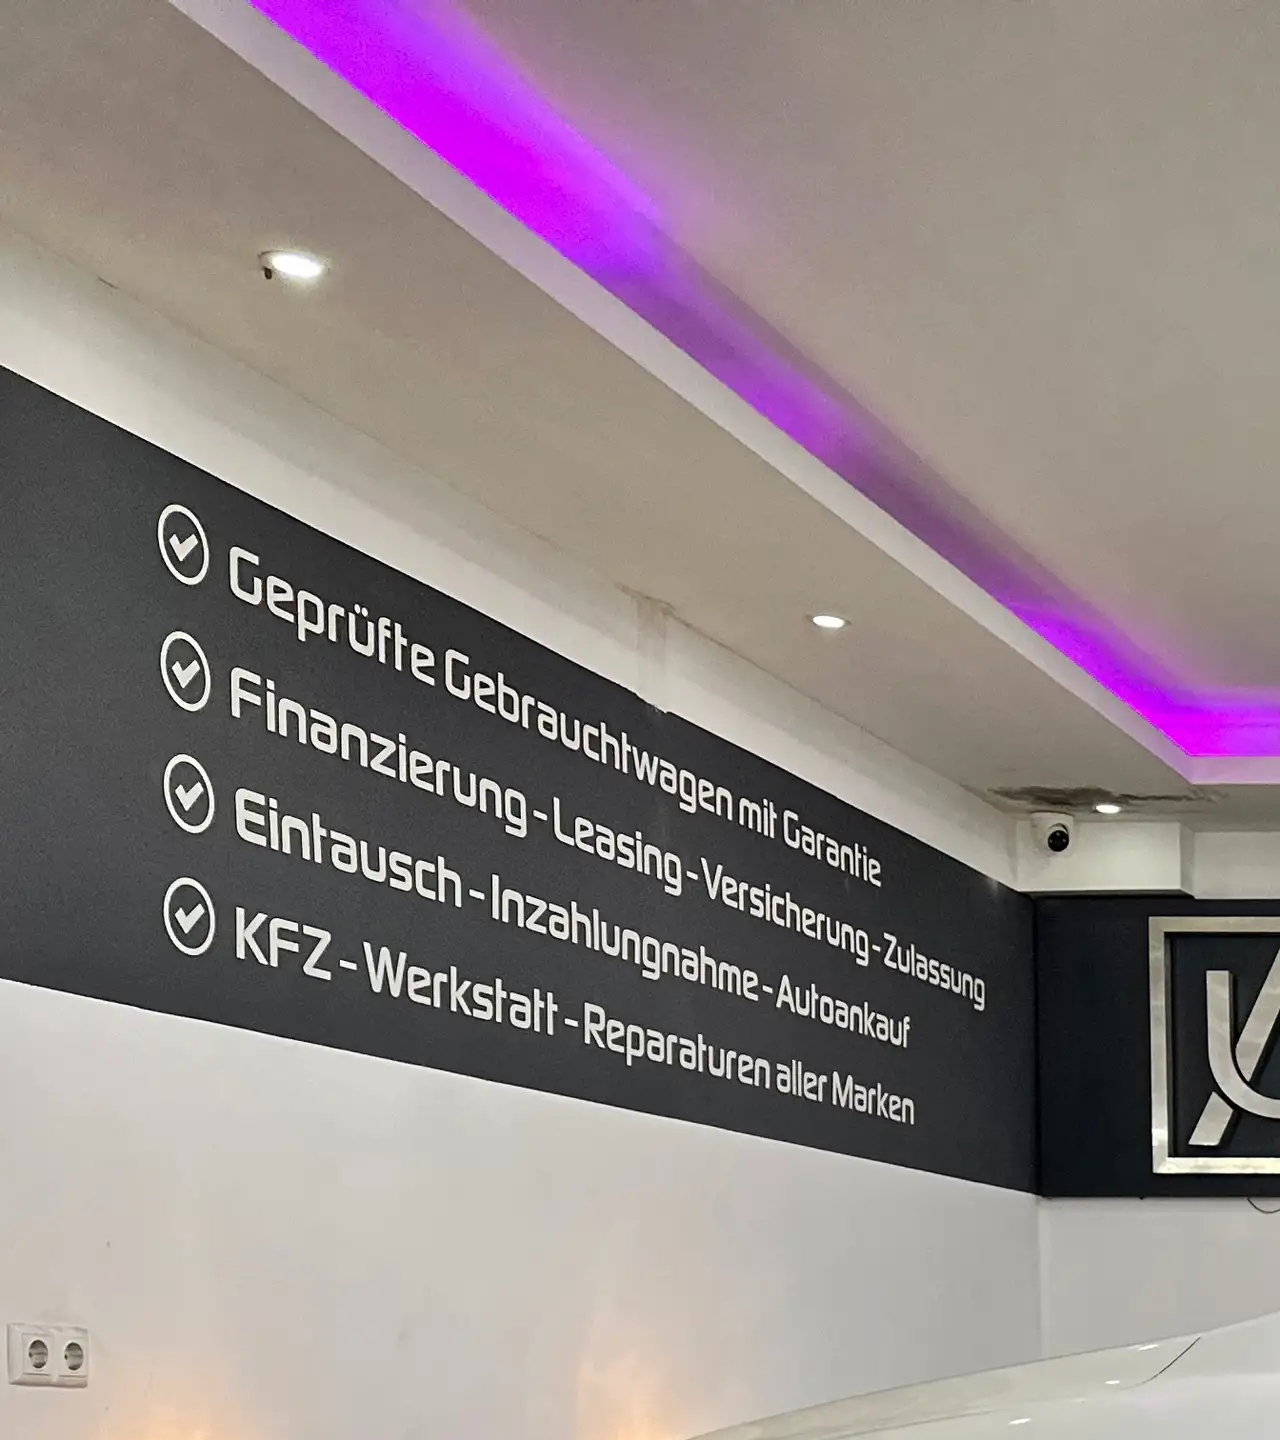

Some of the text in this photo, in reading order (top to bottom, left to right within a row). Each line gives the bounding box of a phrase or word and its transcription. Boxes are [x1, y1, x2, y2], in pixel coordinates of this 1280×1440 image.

[229, 545, 882, 888] Geprüfte Gebrauchtwagen mit Garantie
[777, 1059, 827, 1102] aller
[832, 1070, 914, 1125] Marken
